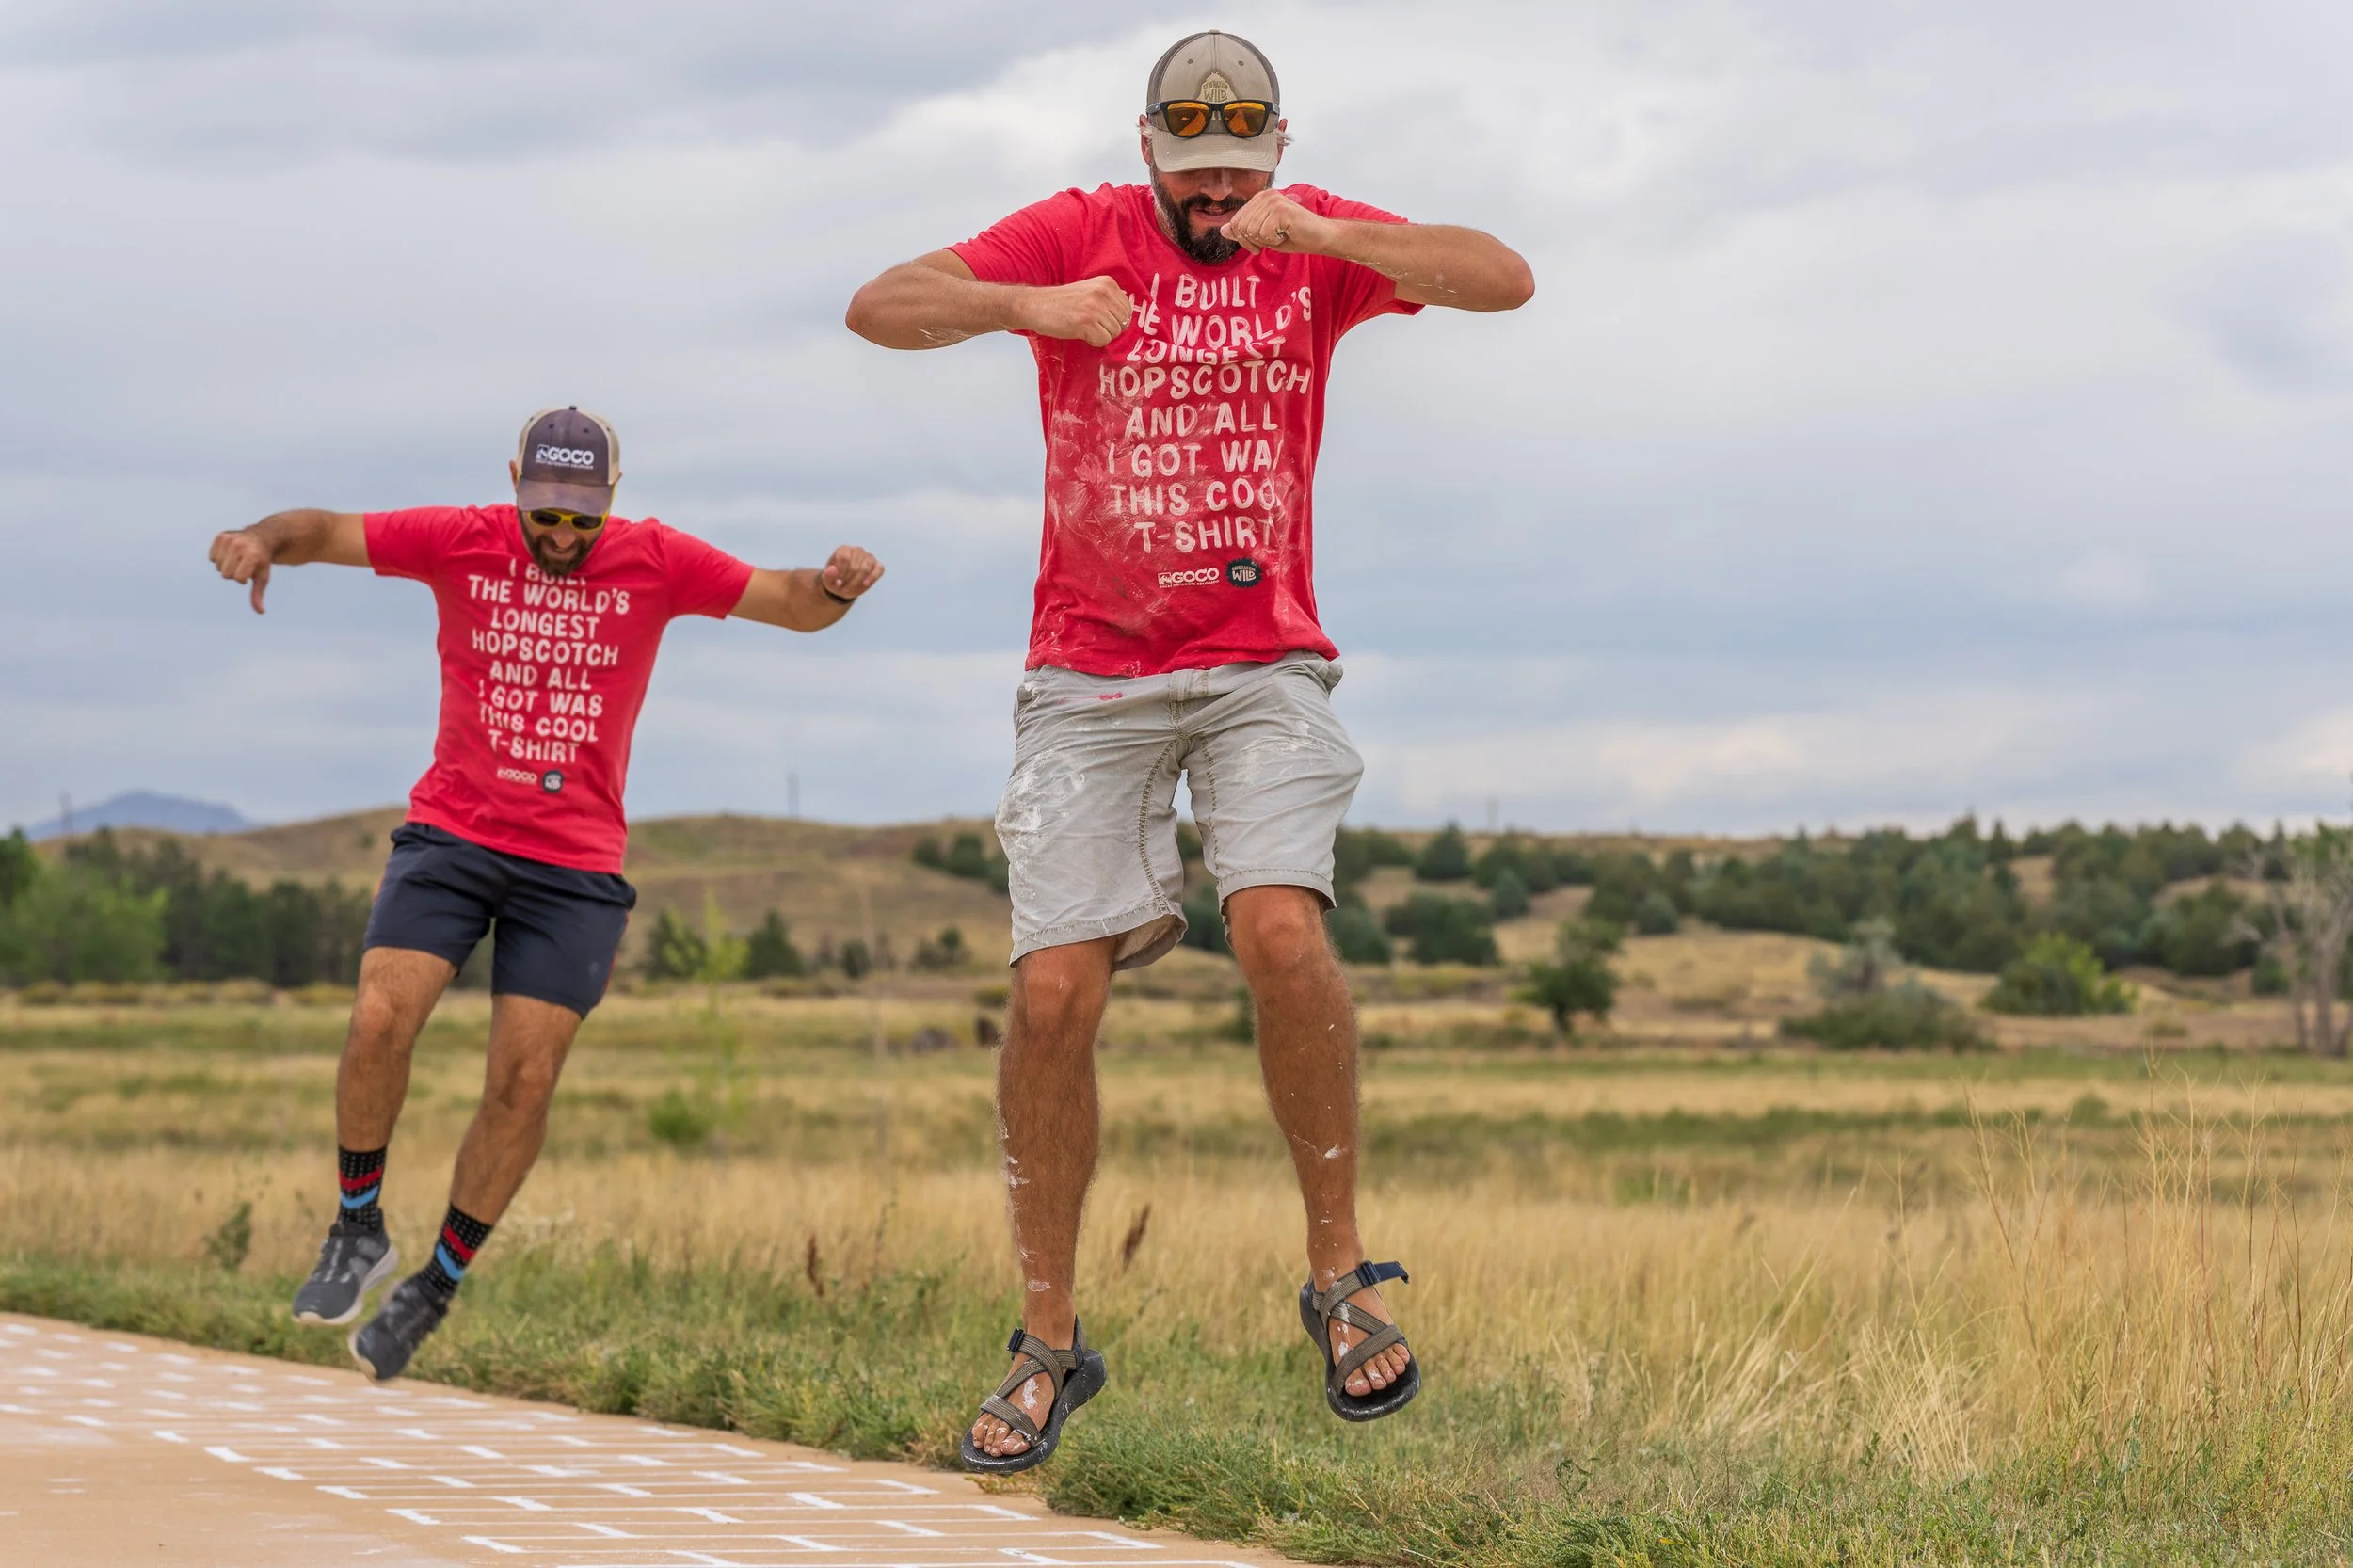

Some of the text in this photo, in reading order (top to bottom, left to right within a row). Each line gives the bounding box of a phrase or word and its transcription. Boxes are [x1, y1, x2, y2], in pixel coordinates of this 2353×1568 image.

[1204, 89, 1227, 102] WILD
[1150, 273, 1260, 310] I BUILT
[1122, 286, 1311, 348] HE WORLD'S
[1127, 337, 1286, 365] LONGEST
[1099, 360, 1313, 399] HOPSCOTCH
[1125, 399, 1278, 439] AND ALL
[548, 446, 595, 466] GOCO
[1106, 443, 1115, 474] I
[1131, 443, 1202, 478] GOT
[1110, 478, 1282, 516] THIS COO
[1134, 515, 1273, 553] T-SHIRT
[509, 557, 517, 577] I
[1171, 568, 1220, 584] GOCO
[1232, 569, 1257, 582] WILD
[468, 574, 630, 615] THE WORLD'S
[490, 606, 600, 640] LONGEST
[472, 628, 619, 666] HOPSCOTCH
[489, 660, 592, 691] AND ALL
[490, 685, 538, 712] GOT
[549, 691, 603, 717] WAS
[479, 700, 599, 742] THIS COOL
[488, 728, 580, 763] T-SHIRT
